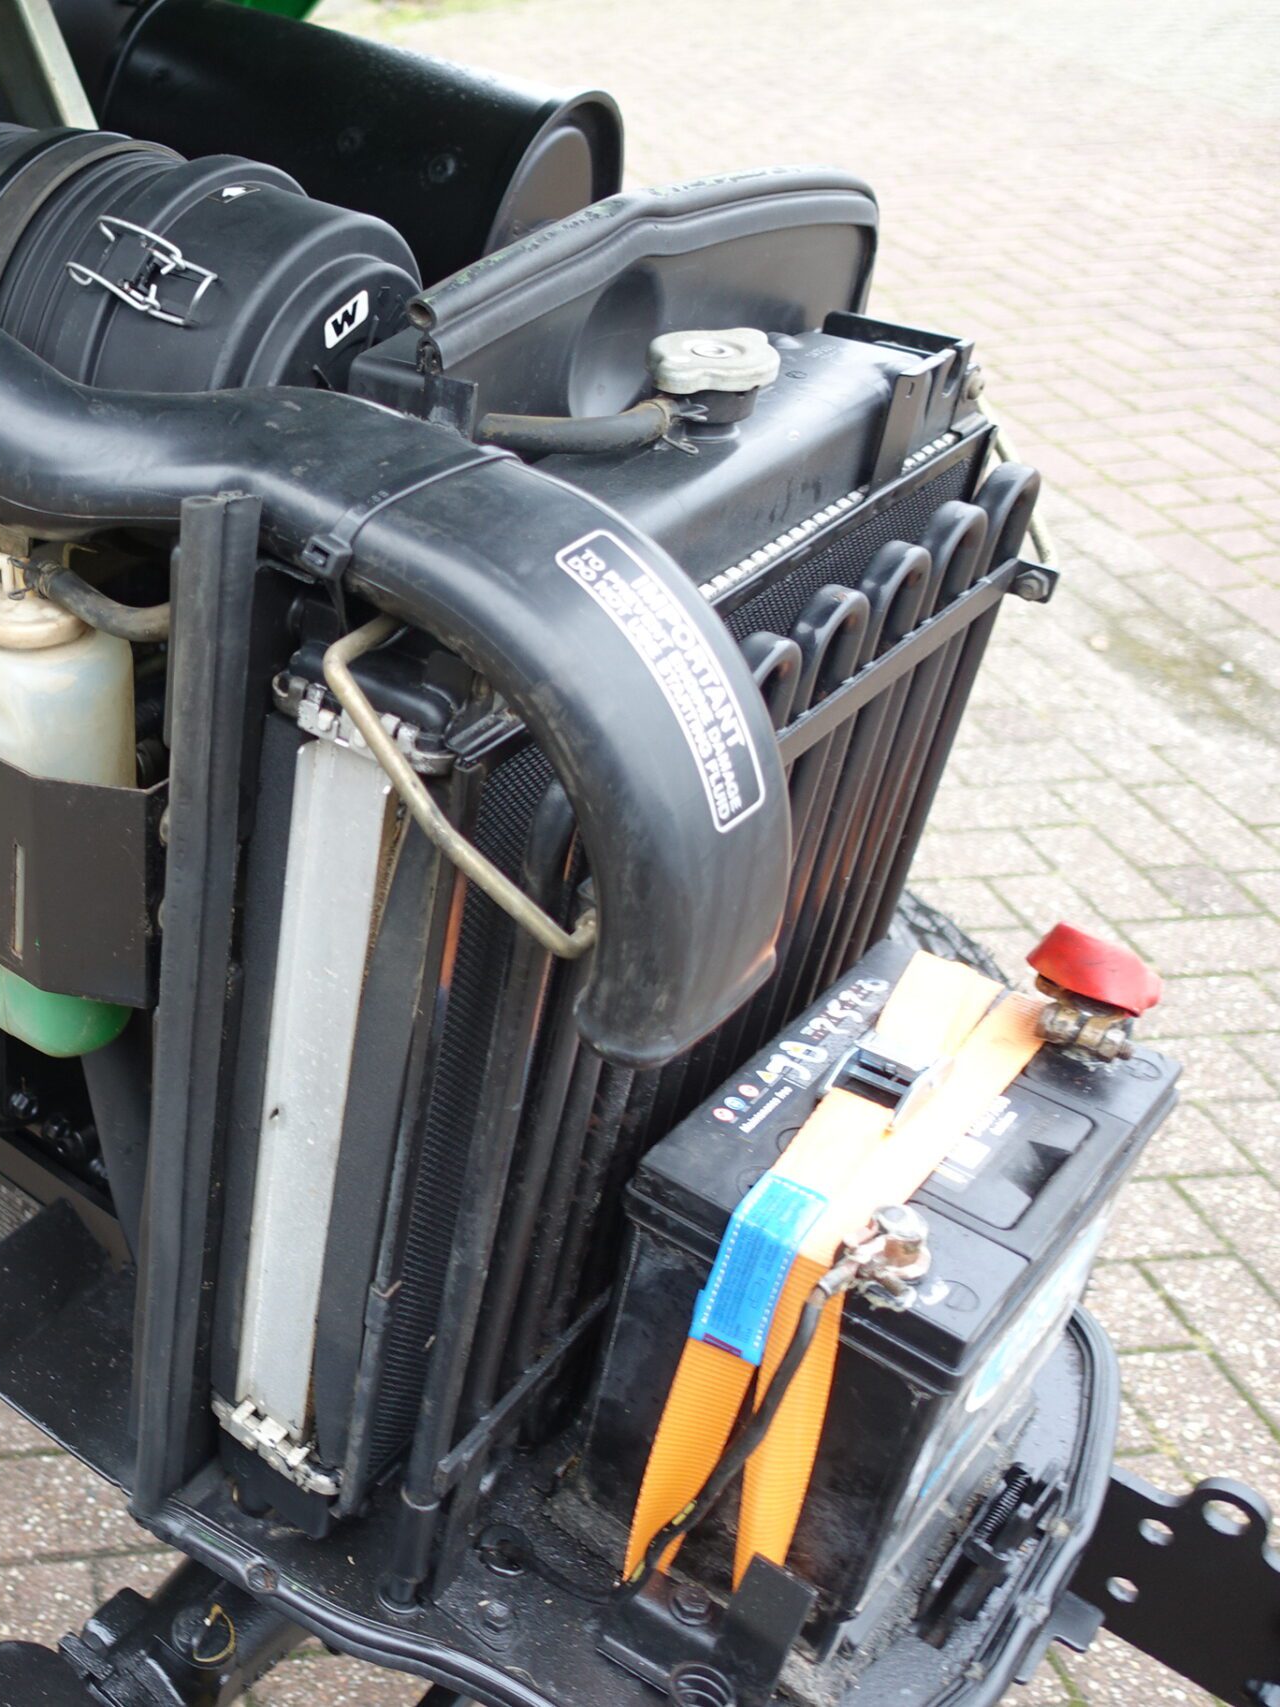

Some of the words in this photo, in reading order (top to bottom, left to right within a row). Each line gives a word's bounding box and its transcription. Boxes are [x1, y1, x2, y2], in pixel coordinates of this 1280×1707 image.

[567, 555, 598, 582] DO
[594, 581, 632, 617] NOT
[656, 659, 710, 759] STARTING
[704, 759, 731, 821] FLUID
[582, 548, 606, 572] TO
[602, 569, 675, 654] PREVENT
[708, 727, 742, 814] DAMAGE
[630, 573, 745, 747] IMPORTANT
